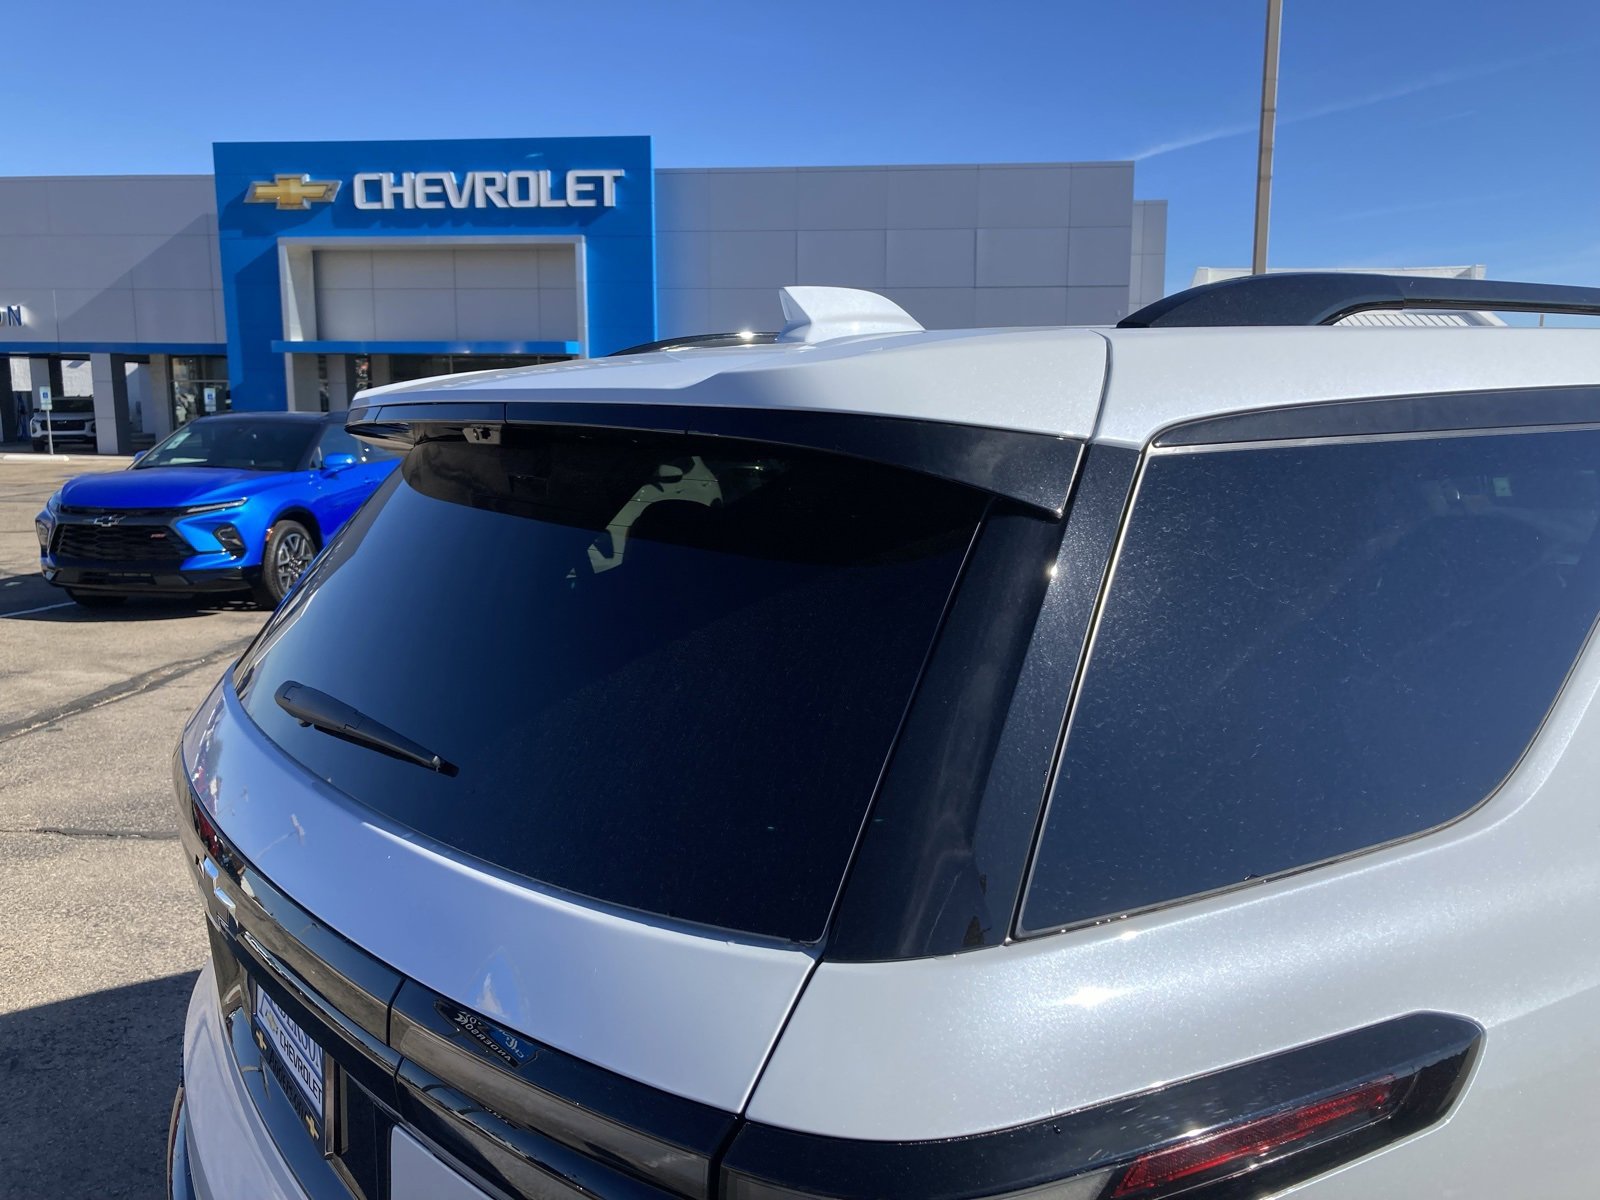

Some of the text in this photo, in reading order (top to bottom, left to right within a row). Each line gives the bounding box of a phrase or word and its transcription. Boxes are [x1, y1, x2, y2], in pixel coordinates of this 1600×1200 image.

[353, 169, 625, 210] CHEVROLET
[0, 304, 22, 327] N
[279, 1030, 322, 1105] CHEVROLET
